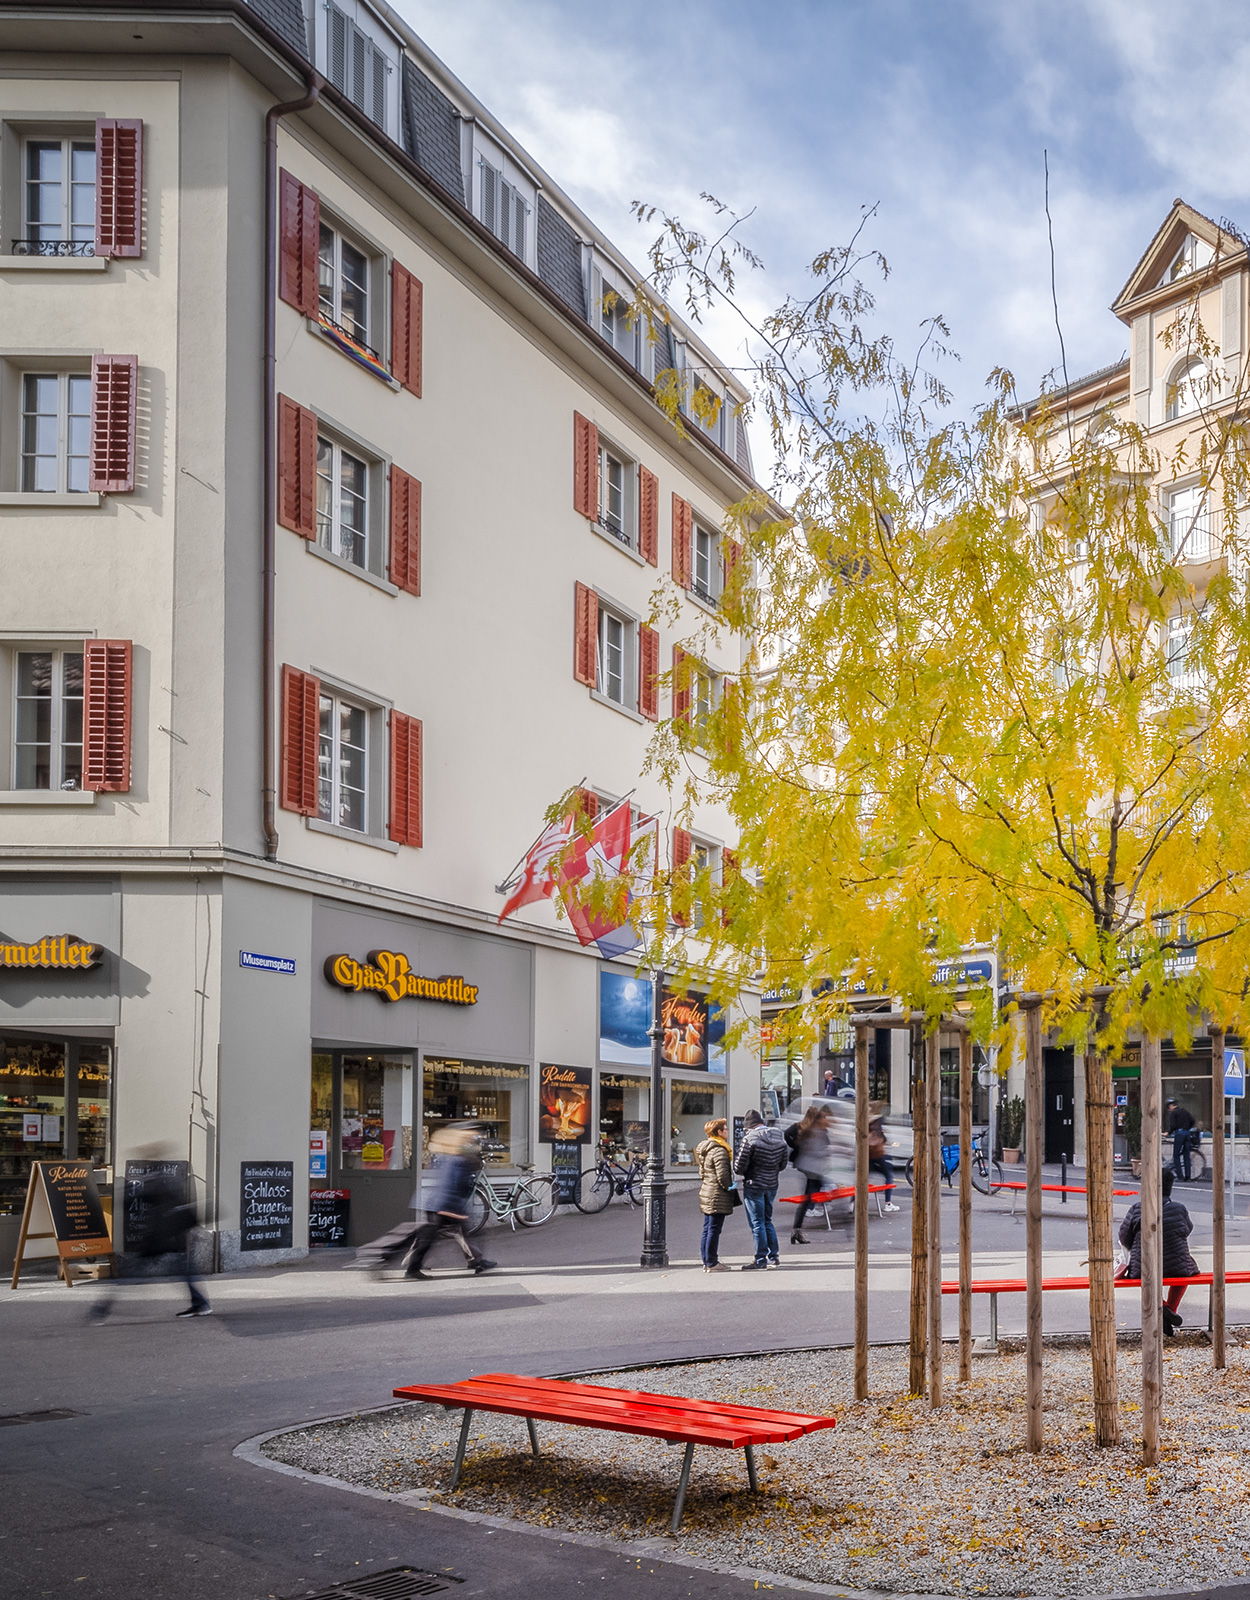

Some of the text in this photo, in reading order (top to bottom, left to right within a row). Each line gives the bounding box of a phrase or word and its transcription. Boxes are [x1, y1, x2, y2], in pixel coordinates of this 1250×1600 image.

[242, 954, 294, 972] Museumsplatz
[661, 994, 706, 1027] Fondue
[1121, 1052, 1141, 1062] HOT
[309, 1213, 341, 1229] Ziger
